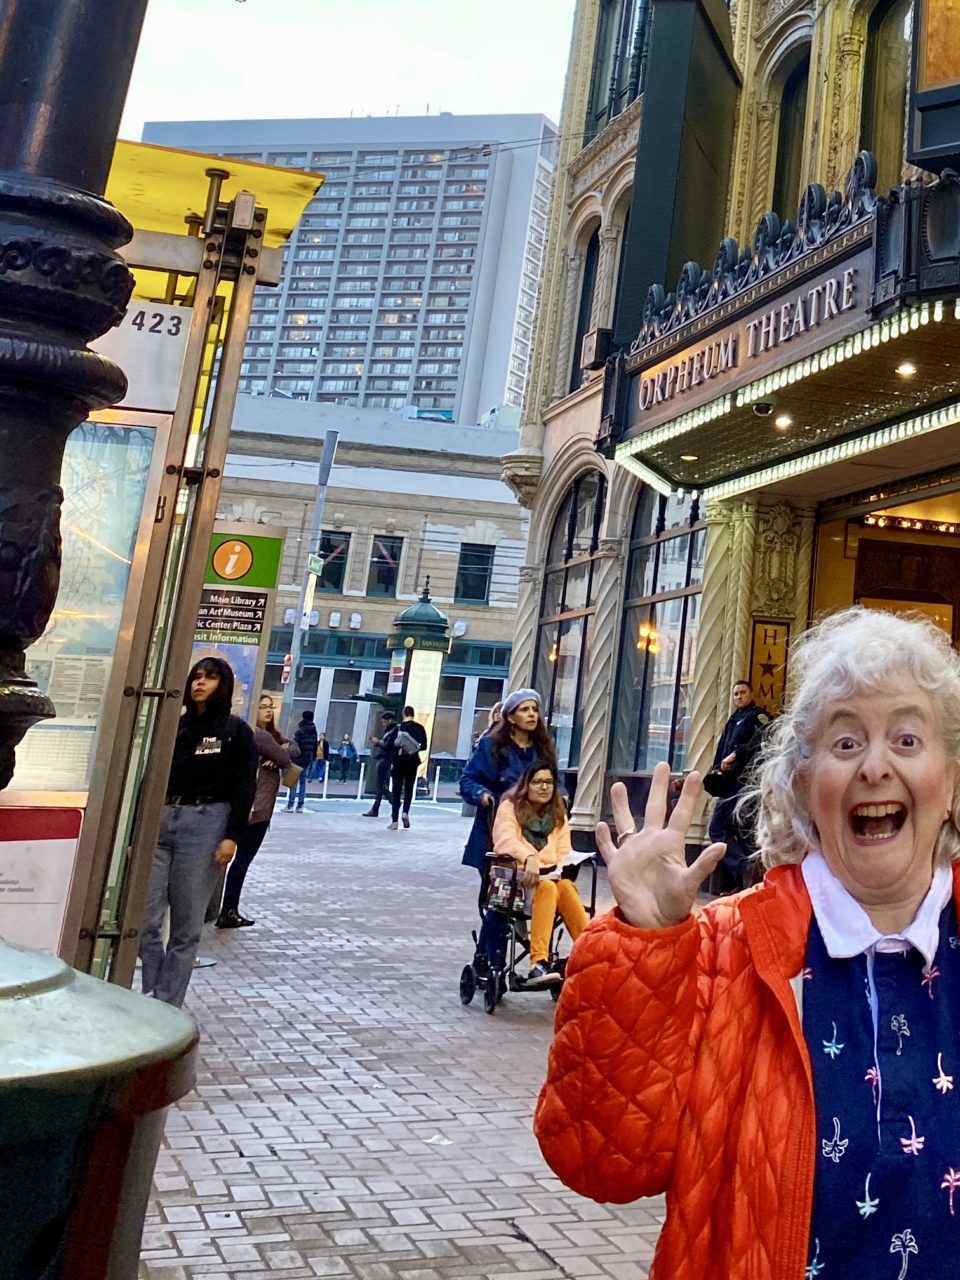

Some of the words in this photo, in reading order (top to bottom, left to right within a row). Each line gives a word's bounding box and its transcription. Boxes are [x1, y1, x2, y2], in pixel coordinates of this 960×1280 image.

[639, 332, 736, 411] ORPHEUM
[746, 267, 857, 358] THEATRE
[210, 595, 229, 604] Main
[230, 596, 256, 607] Library
[223, 609, 254, 618] Museum
[205, 620, 230, 629] Center
[233, 621, 252, 630] Plaza
[209, 632, 258, 644] Information
